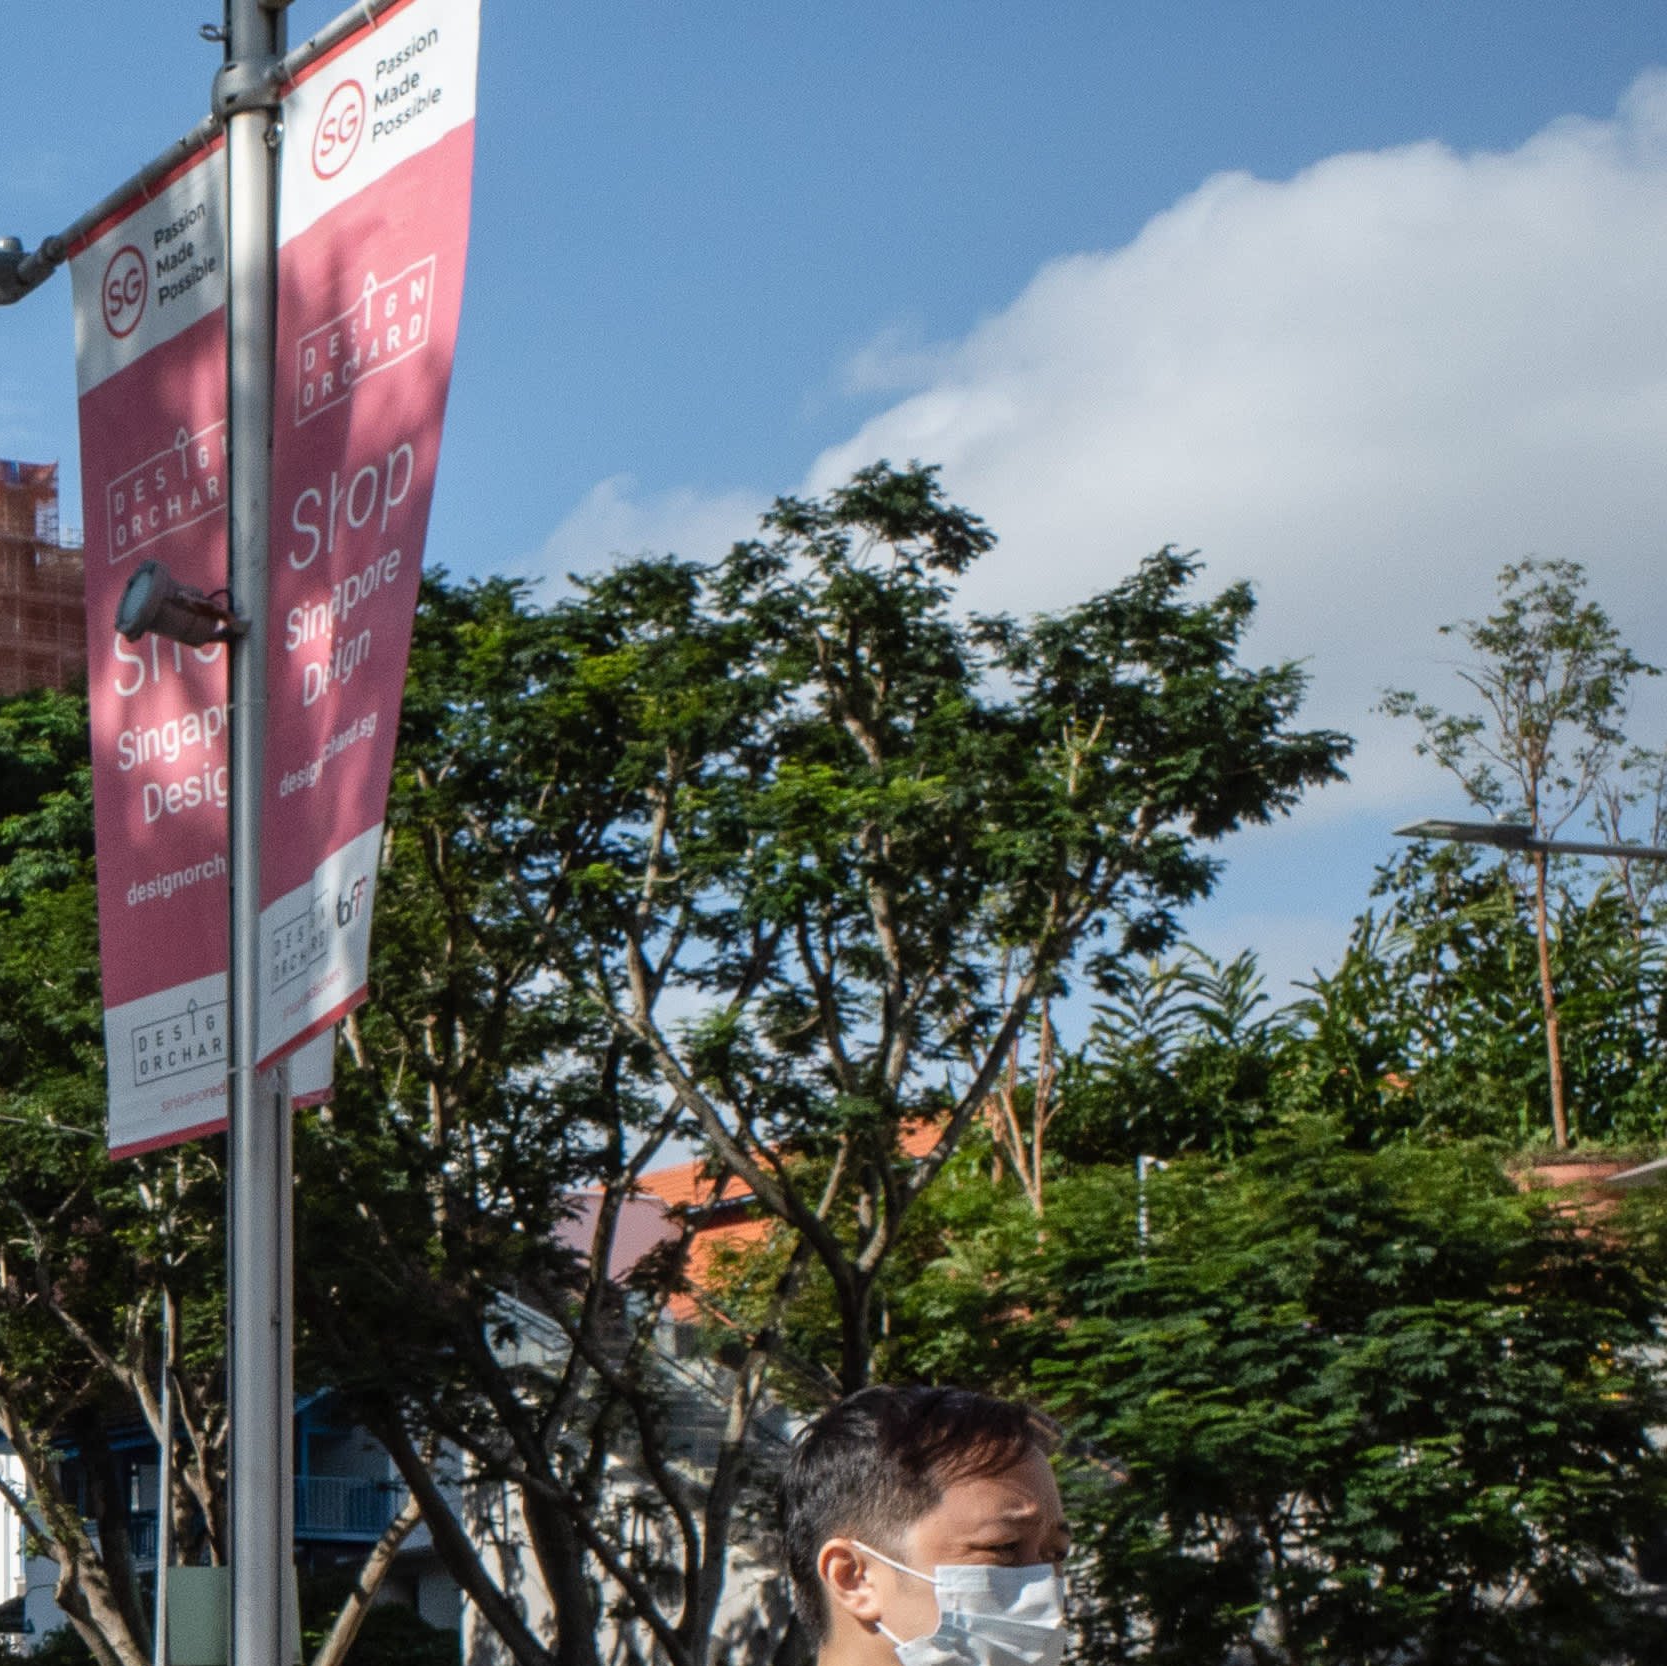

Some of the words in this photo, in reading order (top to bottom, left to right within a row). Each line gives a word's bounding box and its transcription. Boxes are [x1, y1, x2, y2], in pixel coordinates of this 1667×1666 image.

[376, 28, 438, 80] Passion
[372, 87, 441, 143] Possible
[374, 72, 419, 112] Made
[320, 104, 357, 157] SG
[154, 203, 205, 249] Passion
[156, 241, 193, 278] Made
[158, 256, 216, 306] Possible
[108, 268, 141, 316] SG
[117, 704, 228, 772] Singap
